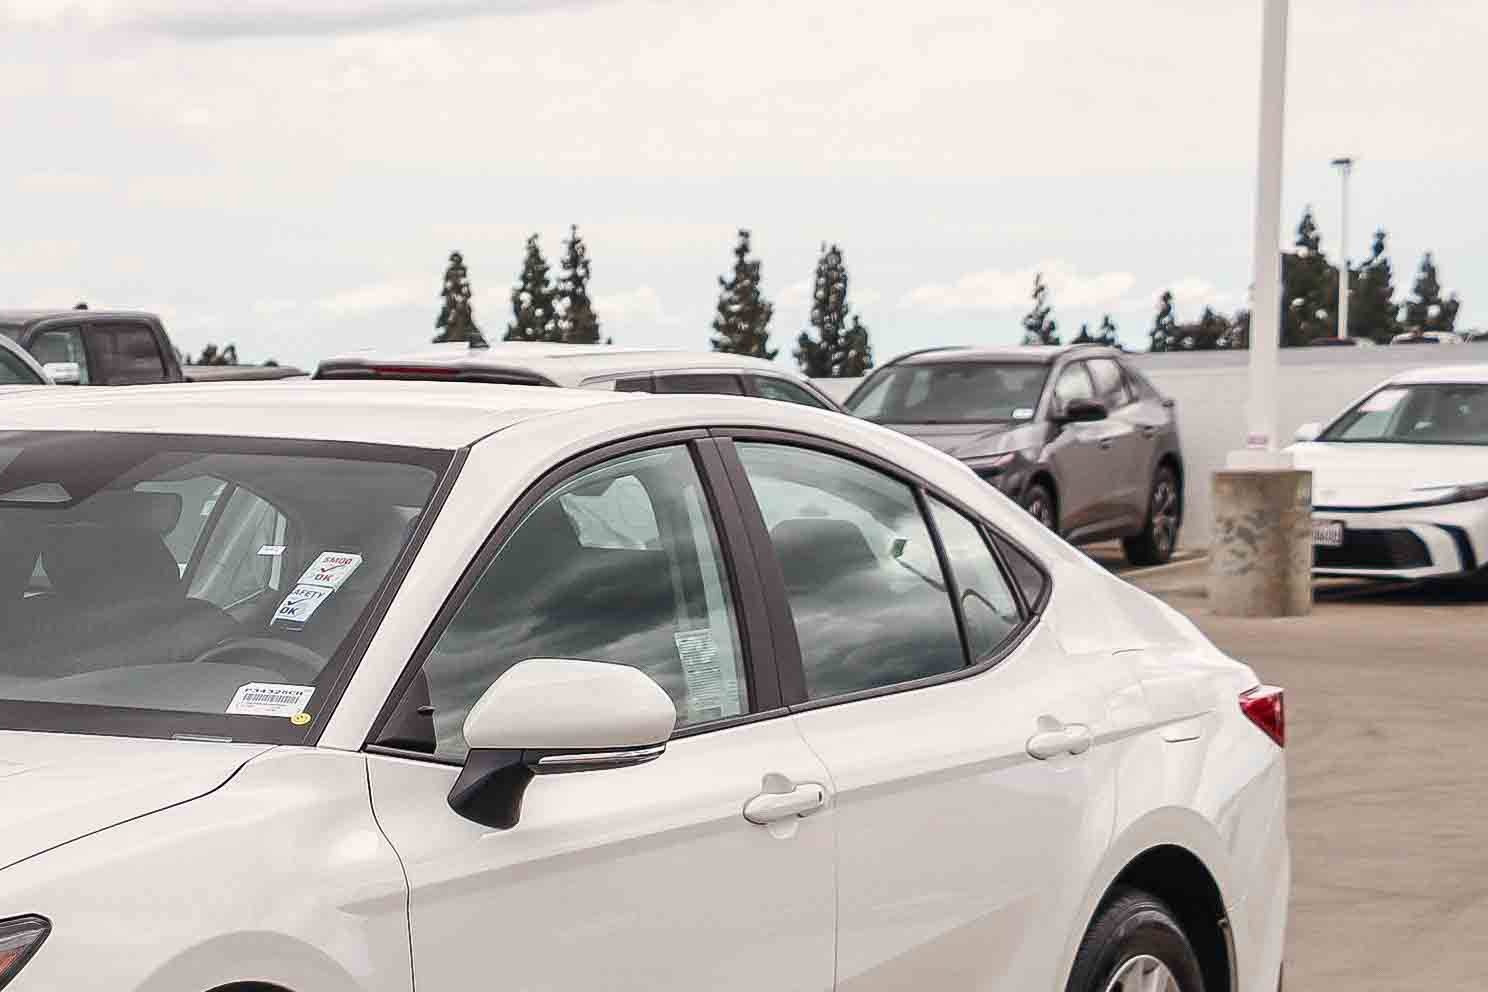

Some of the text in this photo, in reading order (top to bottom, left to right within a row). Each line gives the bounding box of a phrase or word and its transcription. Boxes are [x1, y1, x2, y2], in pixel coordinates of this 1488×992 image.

[314, 573, 332, 582] OK
[293, 588, 326, 599] AFETY
[279, 606, 298, 615] OK
